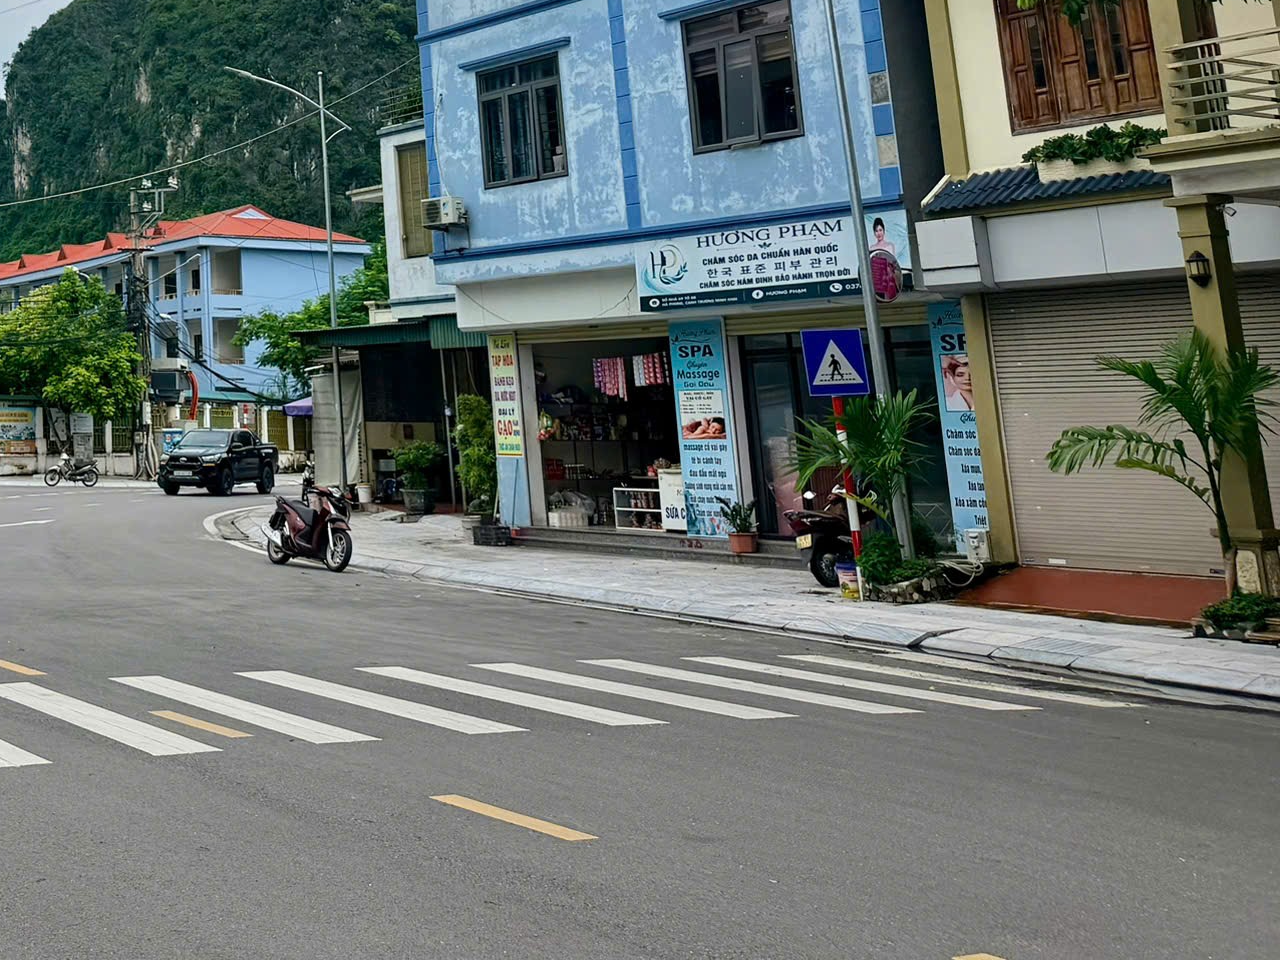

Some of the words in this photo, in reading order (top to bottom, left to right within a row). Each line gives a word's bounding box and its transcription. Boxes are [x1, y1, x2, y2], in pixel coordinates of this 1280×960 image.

[696, 228, 770, 248] HƯƠNG
[778, 219, 843, 238] PHẠM
[728, 254, 745, 263] SÓC
[746, 253, 759, 261] DA
[793, 246, 811, 256] HÀN
[814, 242, 839, 254] QUỐC
[707, 266, 732, 279] 한국
[740, 263, 766, 275] 표준
[774, 259, 802, 271] 피부
[809, 255, 838, 268] 관리
[721, 278, 736, 287] SÓC
[792, 271, 813, 280] HÀNH
[815, 270, 836, 278] TRỌN
[837, 267, 851, 276] ĐỜI
[678, 344, 714, 358] SPA
[940, 334, 966, 351] SP
[491, 355, 502, 369] TẠP
[677, 369, 720, 381] Massage
[497, 420, 513, 440] GẠO
